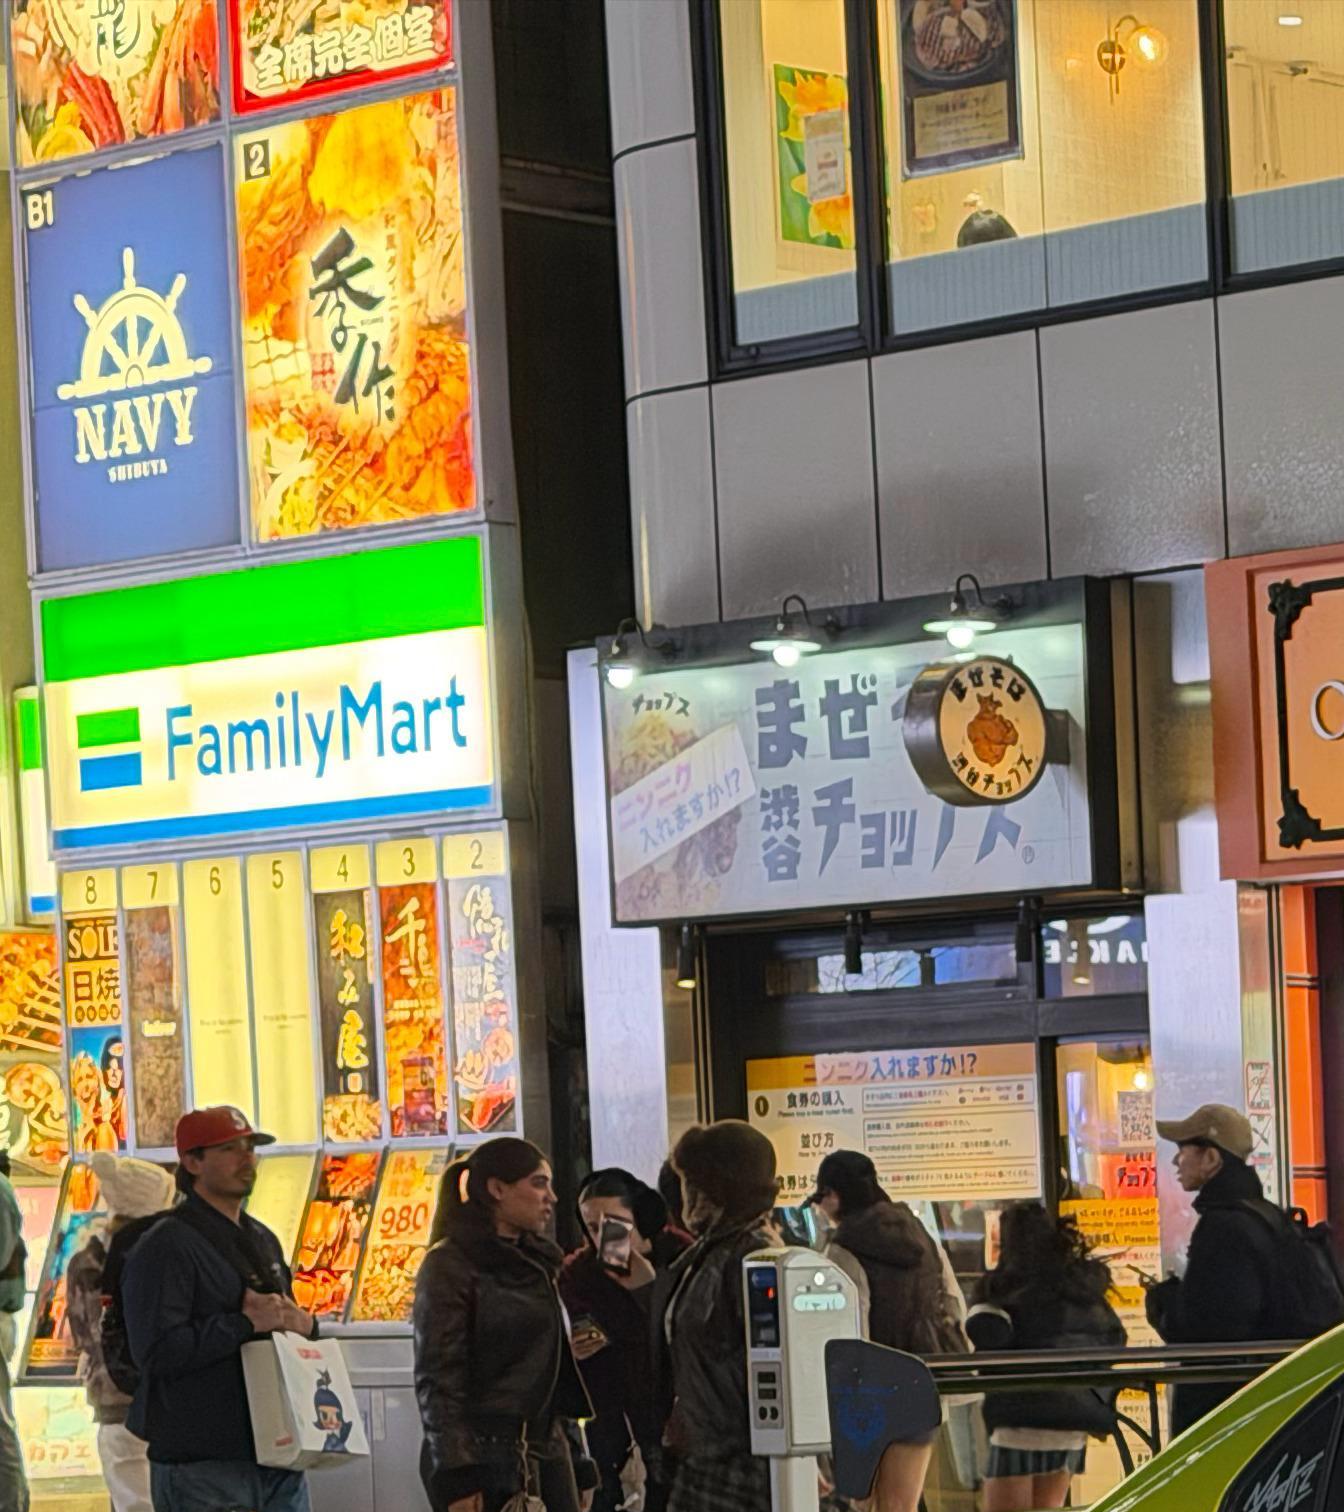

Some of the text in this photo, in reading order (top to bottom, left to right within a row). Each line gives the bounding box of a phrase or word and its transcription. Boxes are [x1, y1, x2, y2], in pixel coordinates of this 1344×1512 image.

[255, 5, 436, 89] 全席完全個室
[248, 143, 266, 175] 2
[27, 191, 54, 230] B1
[74, 387, 198, 463] NAVY
[108, 459, 168, 483] SHIBUYA
[166, 674, 468, 782] FamilyMart
[755, 672, 908, 769] まぜ
[336, 854, 350, 883] 4
[402, 848, 416, 877] 3
[470, 841, 483, 870] 2
[147, 872, 158, 899] 7
[209, 867, 221, 895] 6
[272, 860, 284, 889] 5
[86, 876, 97, 904] 8
